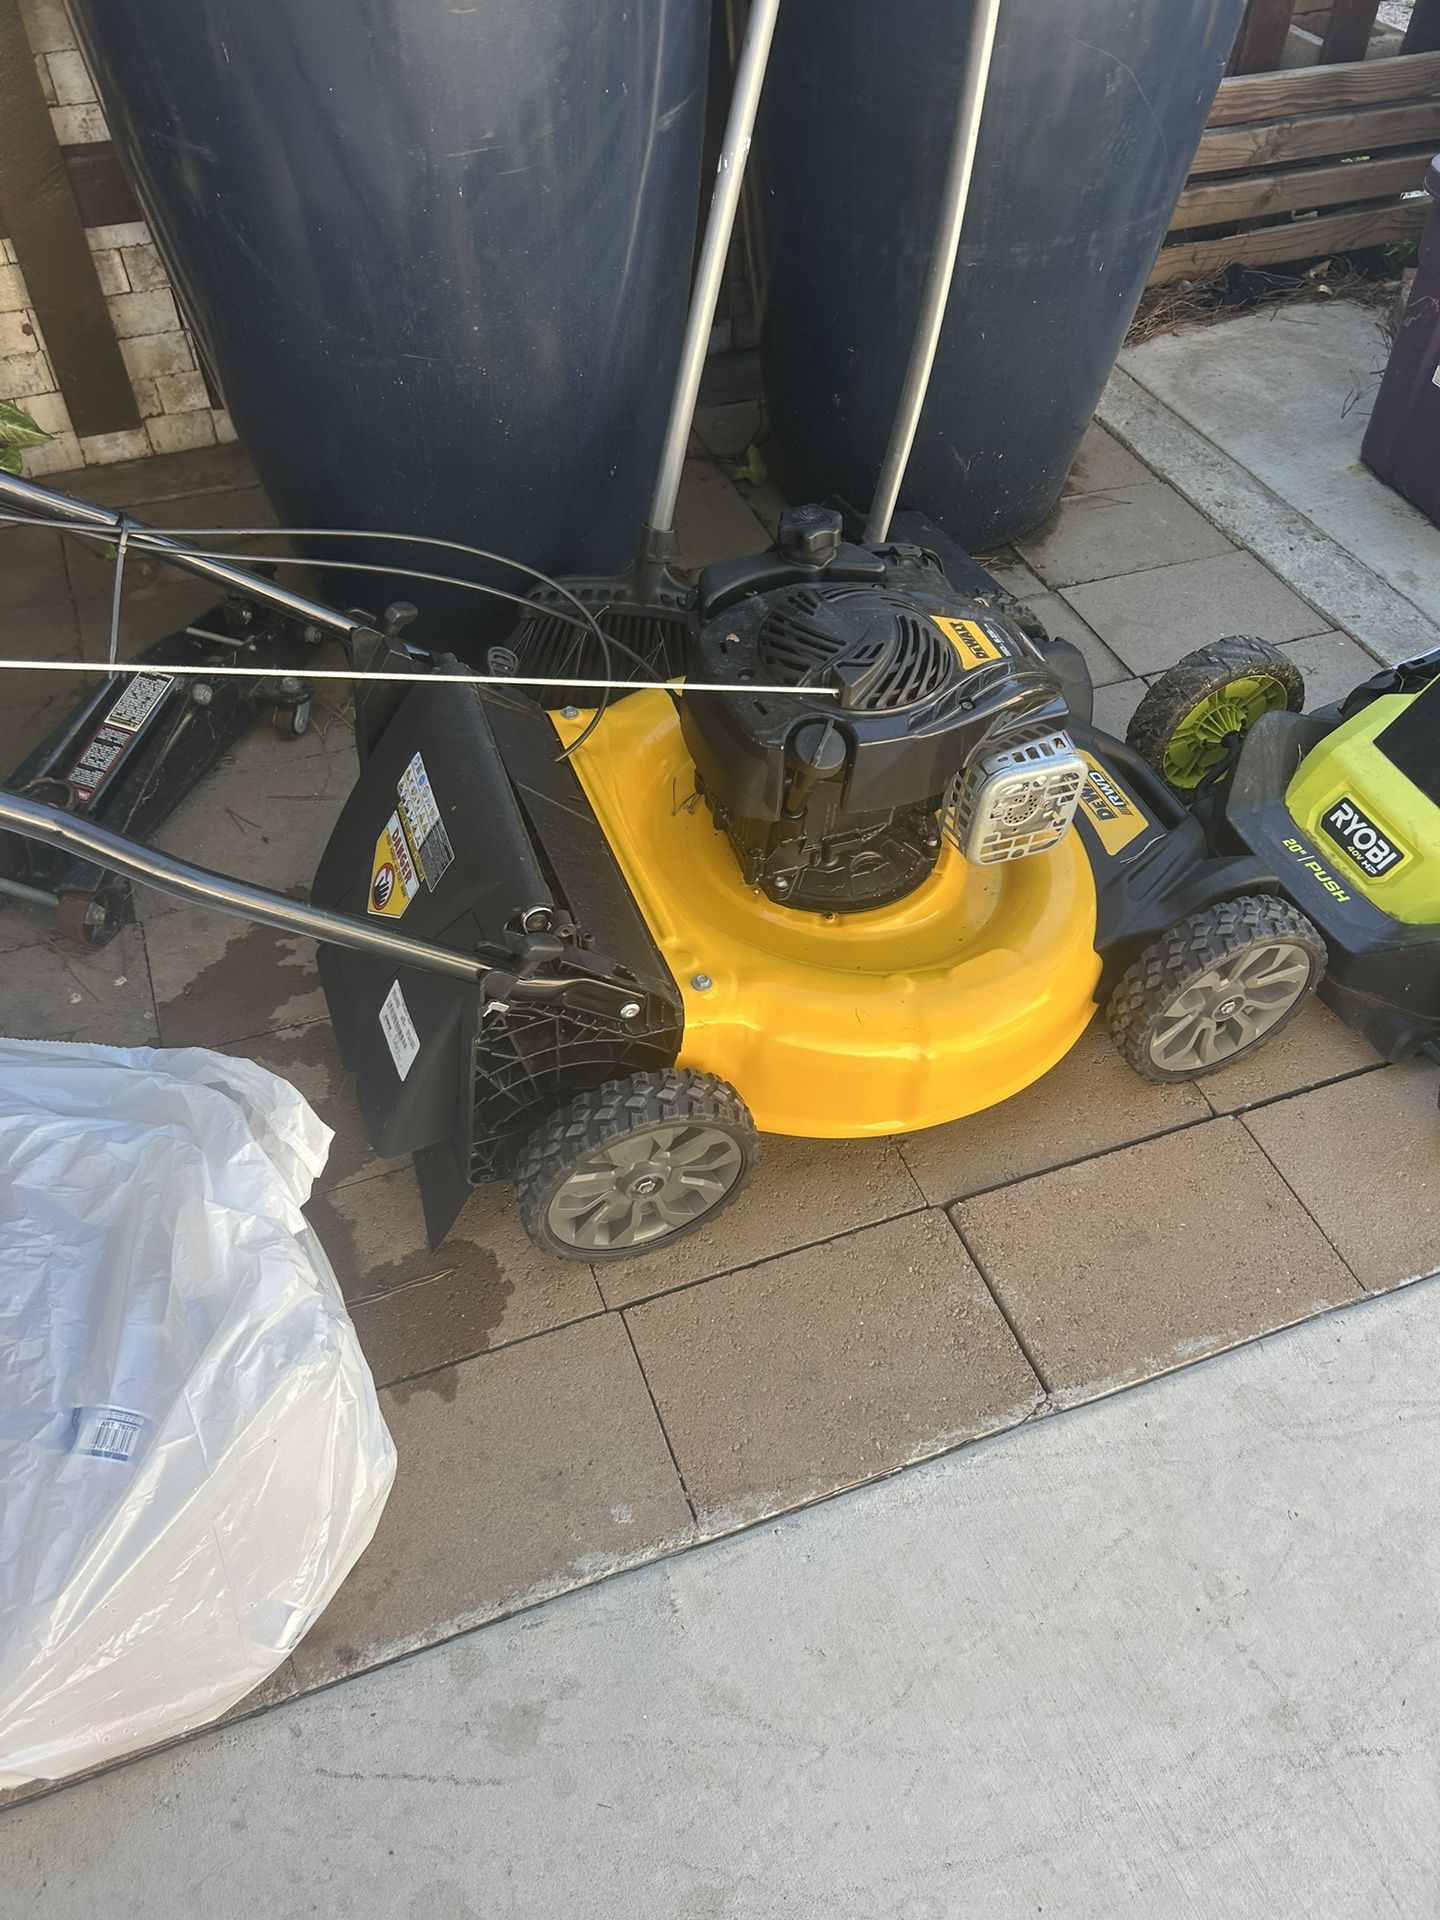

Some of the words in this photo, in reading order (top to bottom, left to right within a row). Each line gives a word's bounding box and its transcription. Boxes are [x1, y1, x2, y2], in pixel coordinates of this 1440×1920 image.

[949, 622, 990, 658] DEWALT
[1081, 782, 1118, 820] DEW
[1088, 771, 1126, 807] RWD
[1329, 802, 1398, 871] RYOBI
[391, 827, 413, 885] DANGER
[1346, 846, 1365, 861] 40V
[1361, 860, 1378, 875] HP
[1304, 861, 1351, 903] PUSH
